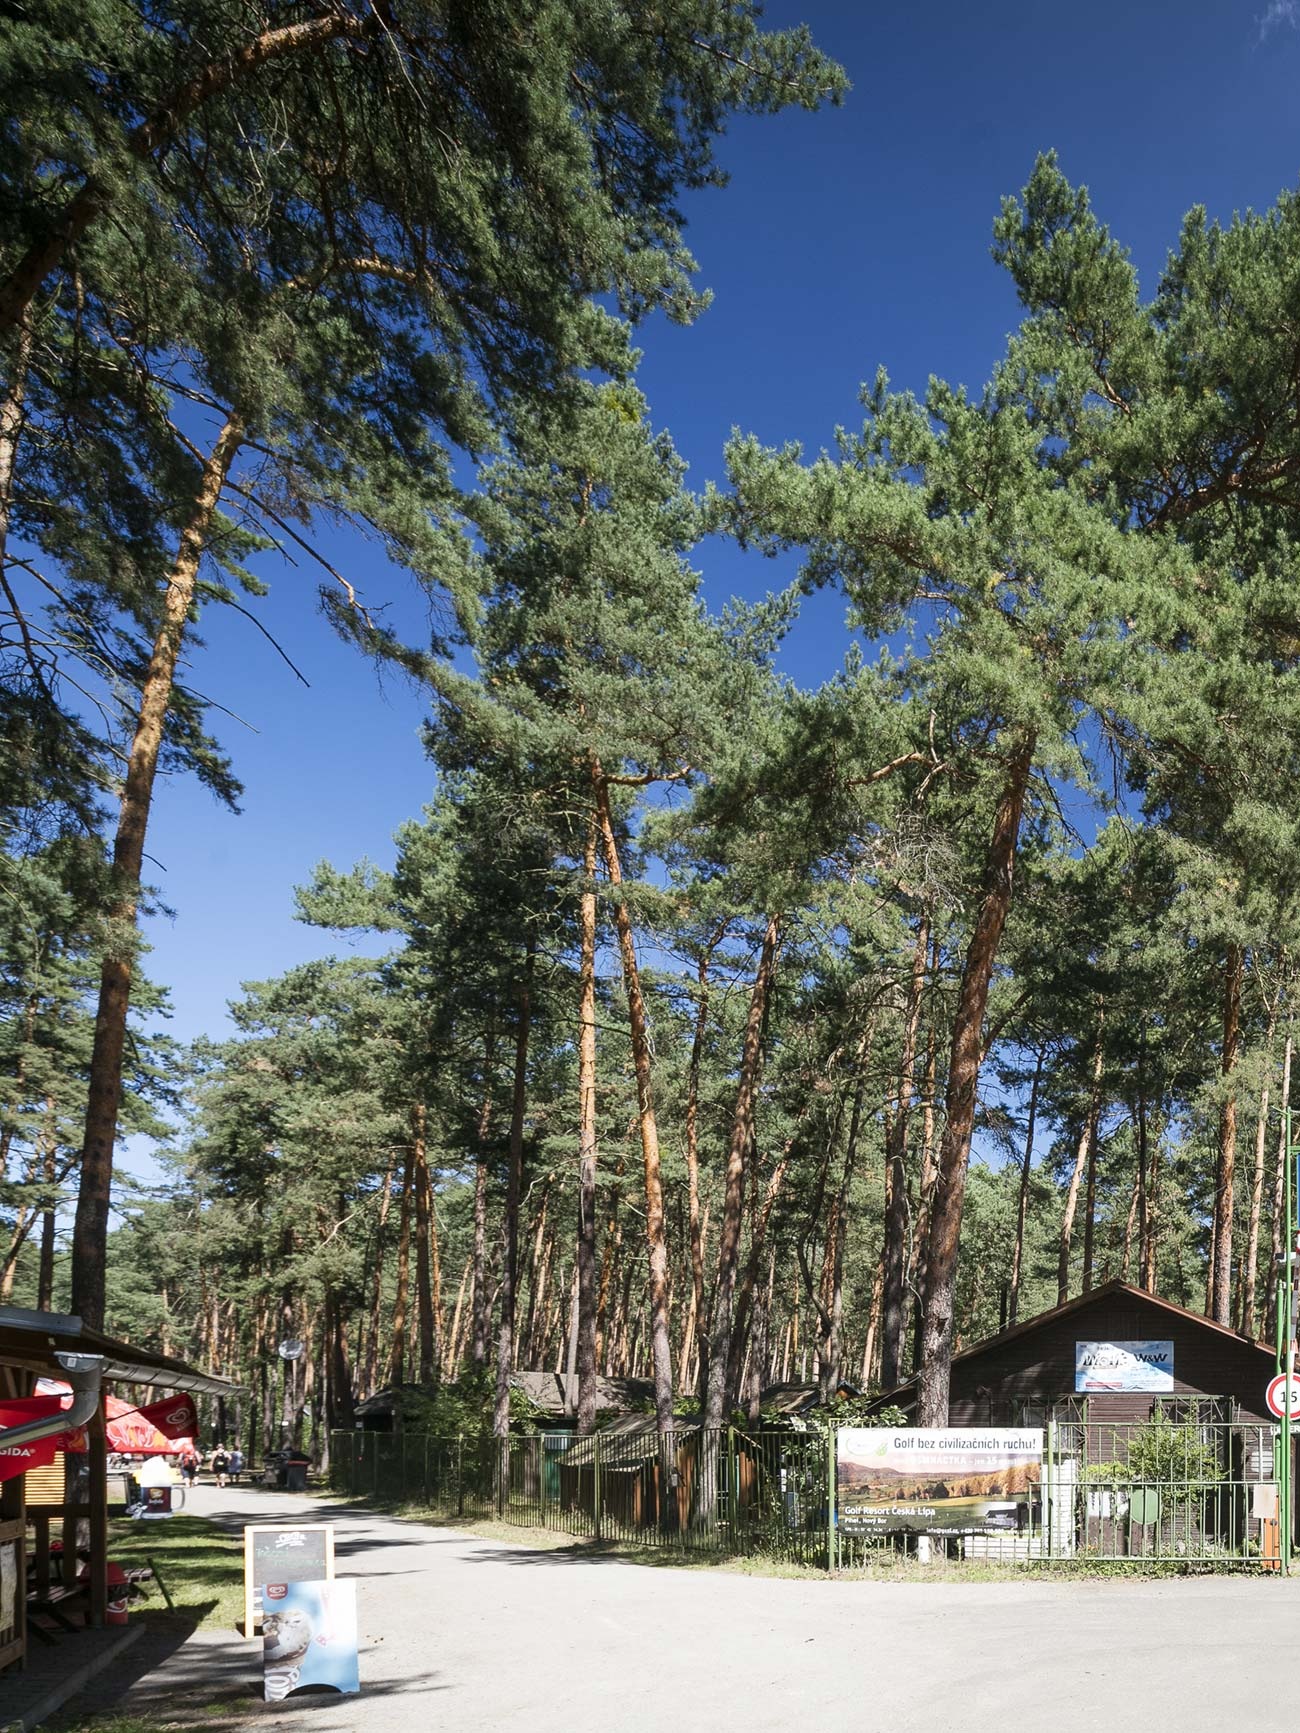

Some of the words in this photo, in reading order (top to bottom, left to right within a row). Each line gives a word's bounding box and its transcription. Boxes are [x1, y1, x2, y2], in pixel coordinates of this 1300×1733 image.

[1280, 1391, 1298, 1403] 15
[894, 1437, 915, 1449] Golf
[918, 1438, 935, 1449] bez
[1003, 1438, 1036, 1450] ruchu!
[844, 1506, 861, 1516] Golf
[863, 1506, 890, 1516] Resort
[892, 1504, 916, 1516] Česká
[917, 1506, 936, 1519] Lípa
